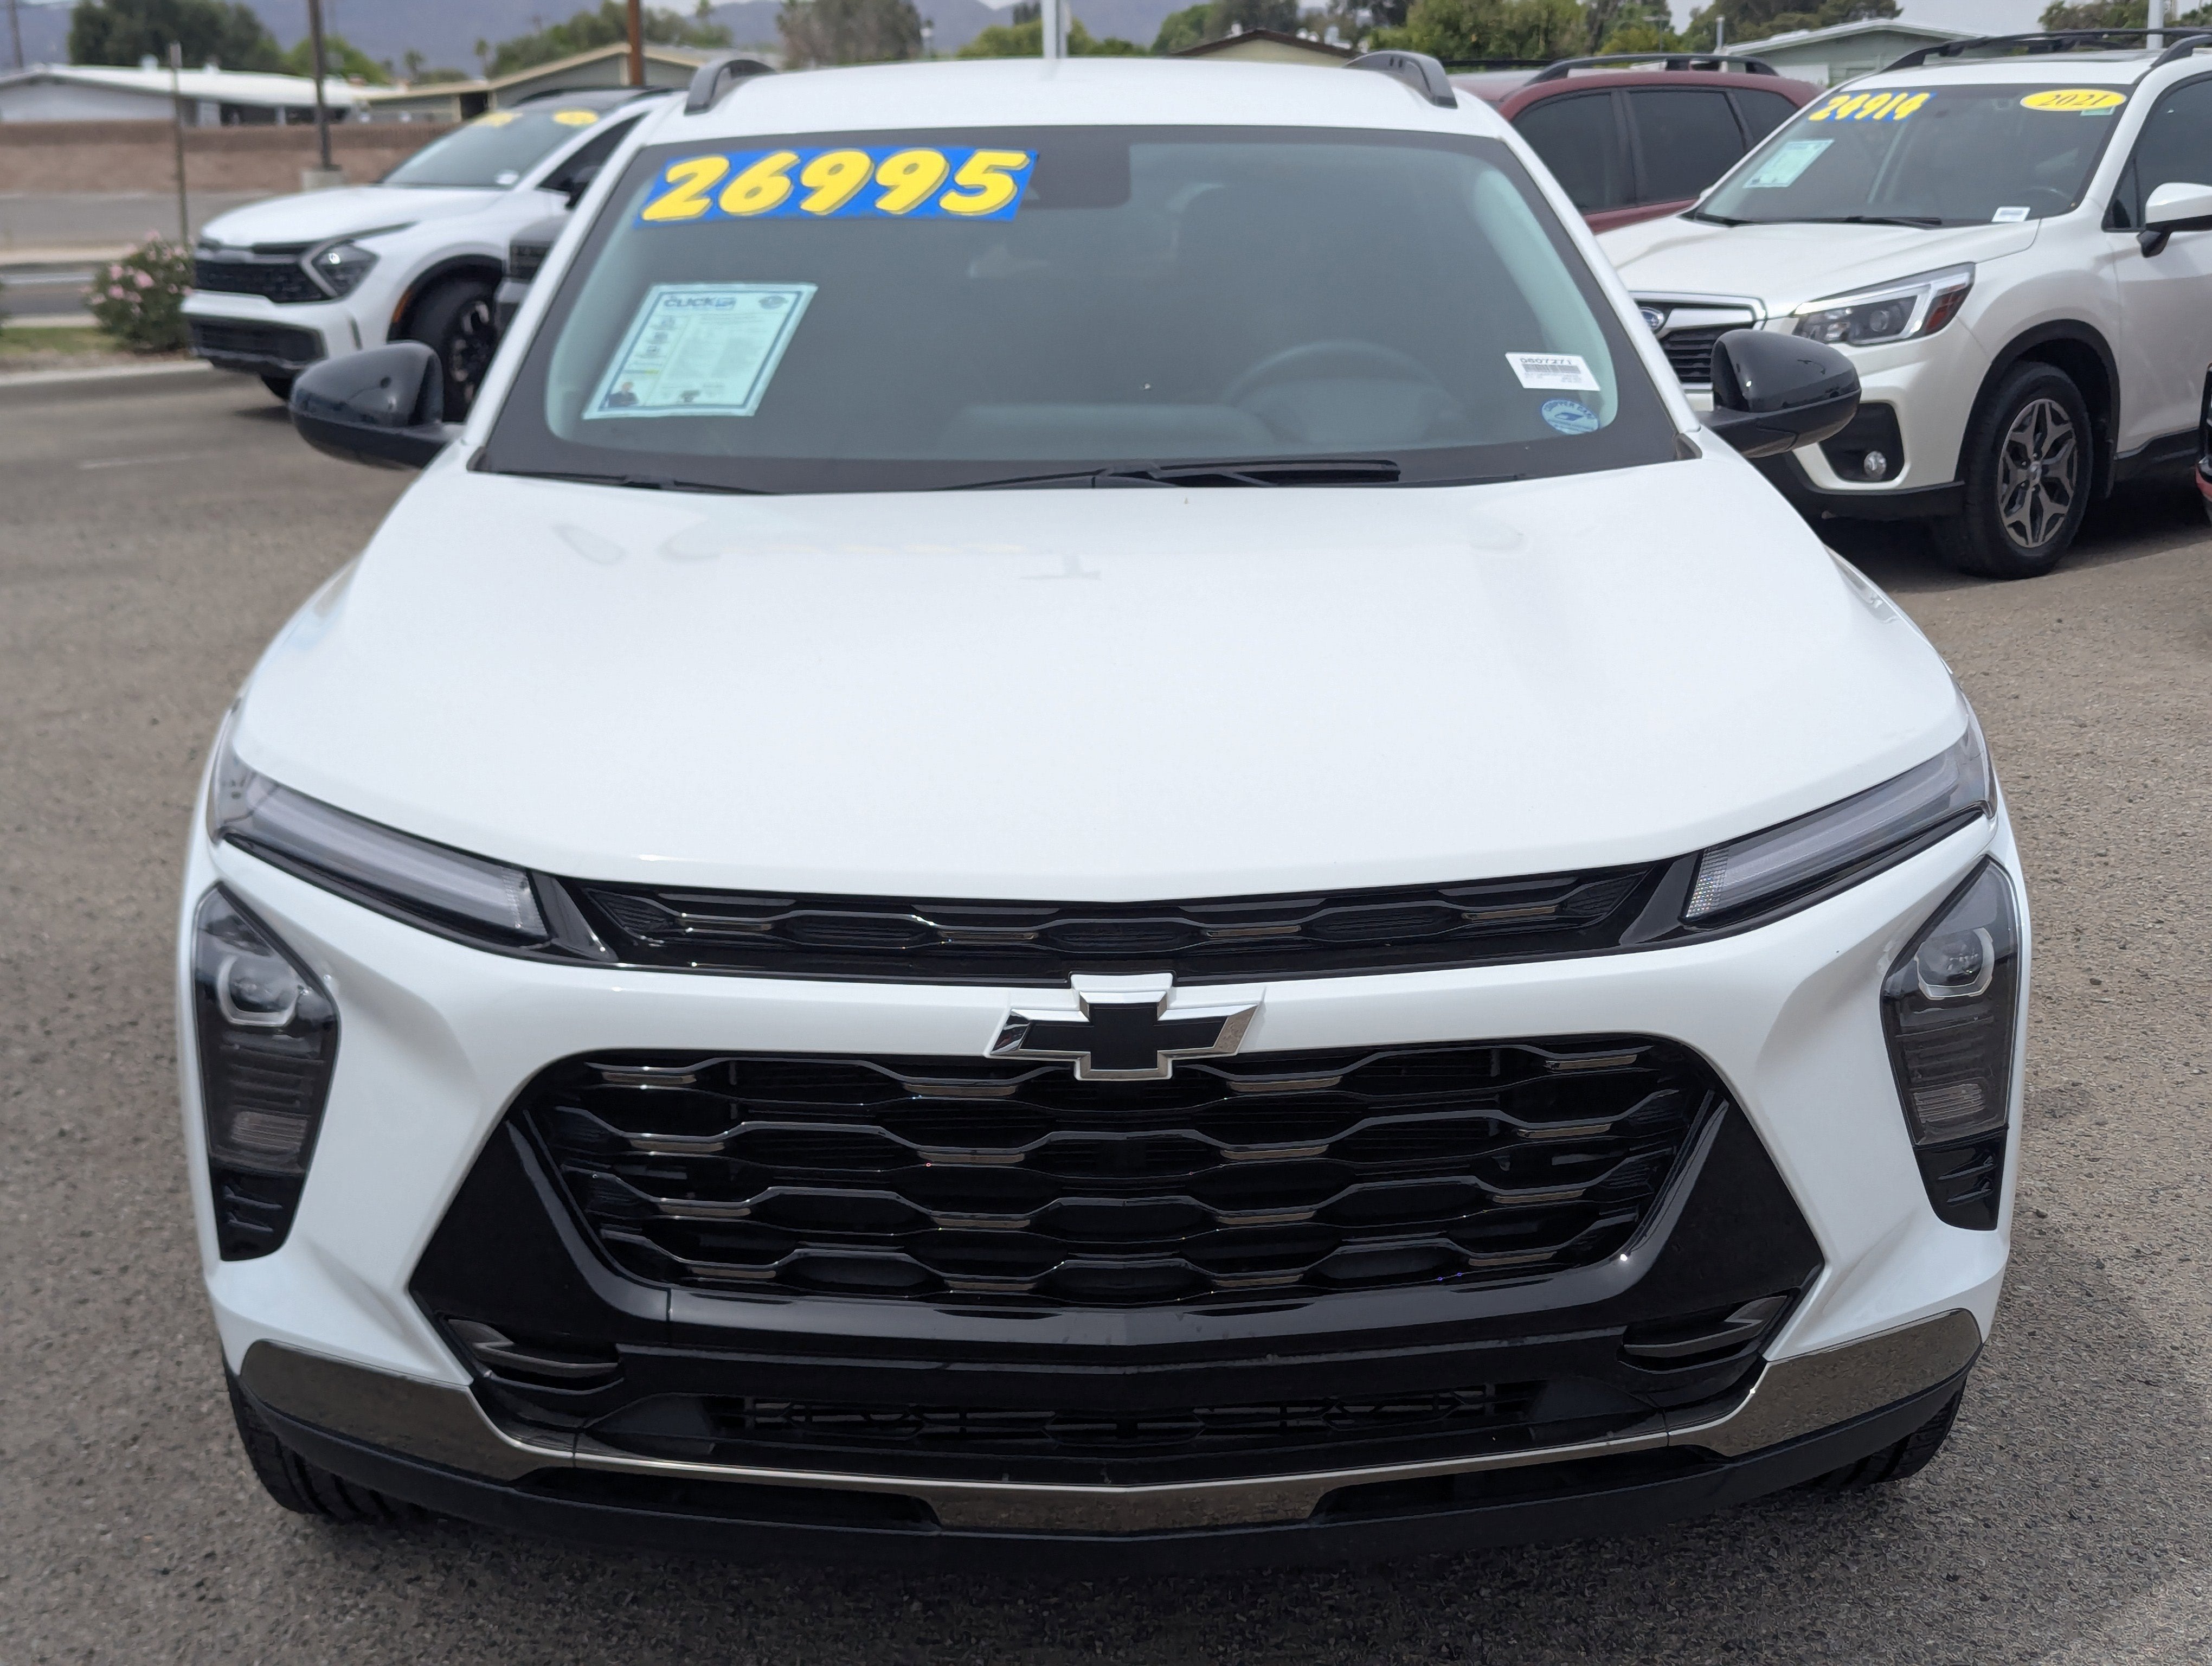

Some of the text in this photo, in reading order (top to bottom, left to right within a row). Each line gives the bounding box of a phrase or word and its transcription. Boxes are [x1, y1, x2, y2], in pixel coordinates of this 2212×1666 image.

[1808, 93, 1930, 121] 24914
[2037, 94, 2111, 107] 2021
[642, 148, 1029, 221] 26995
